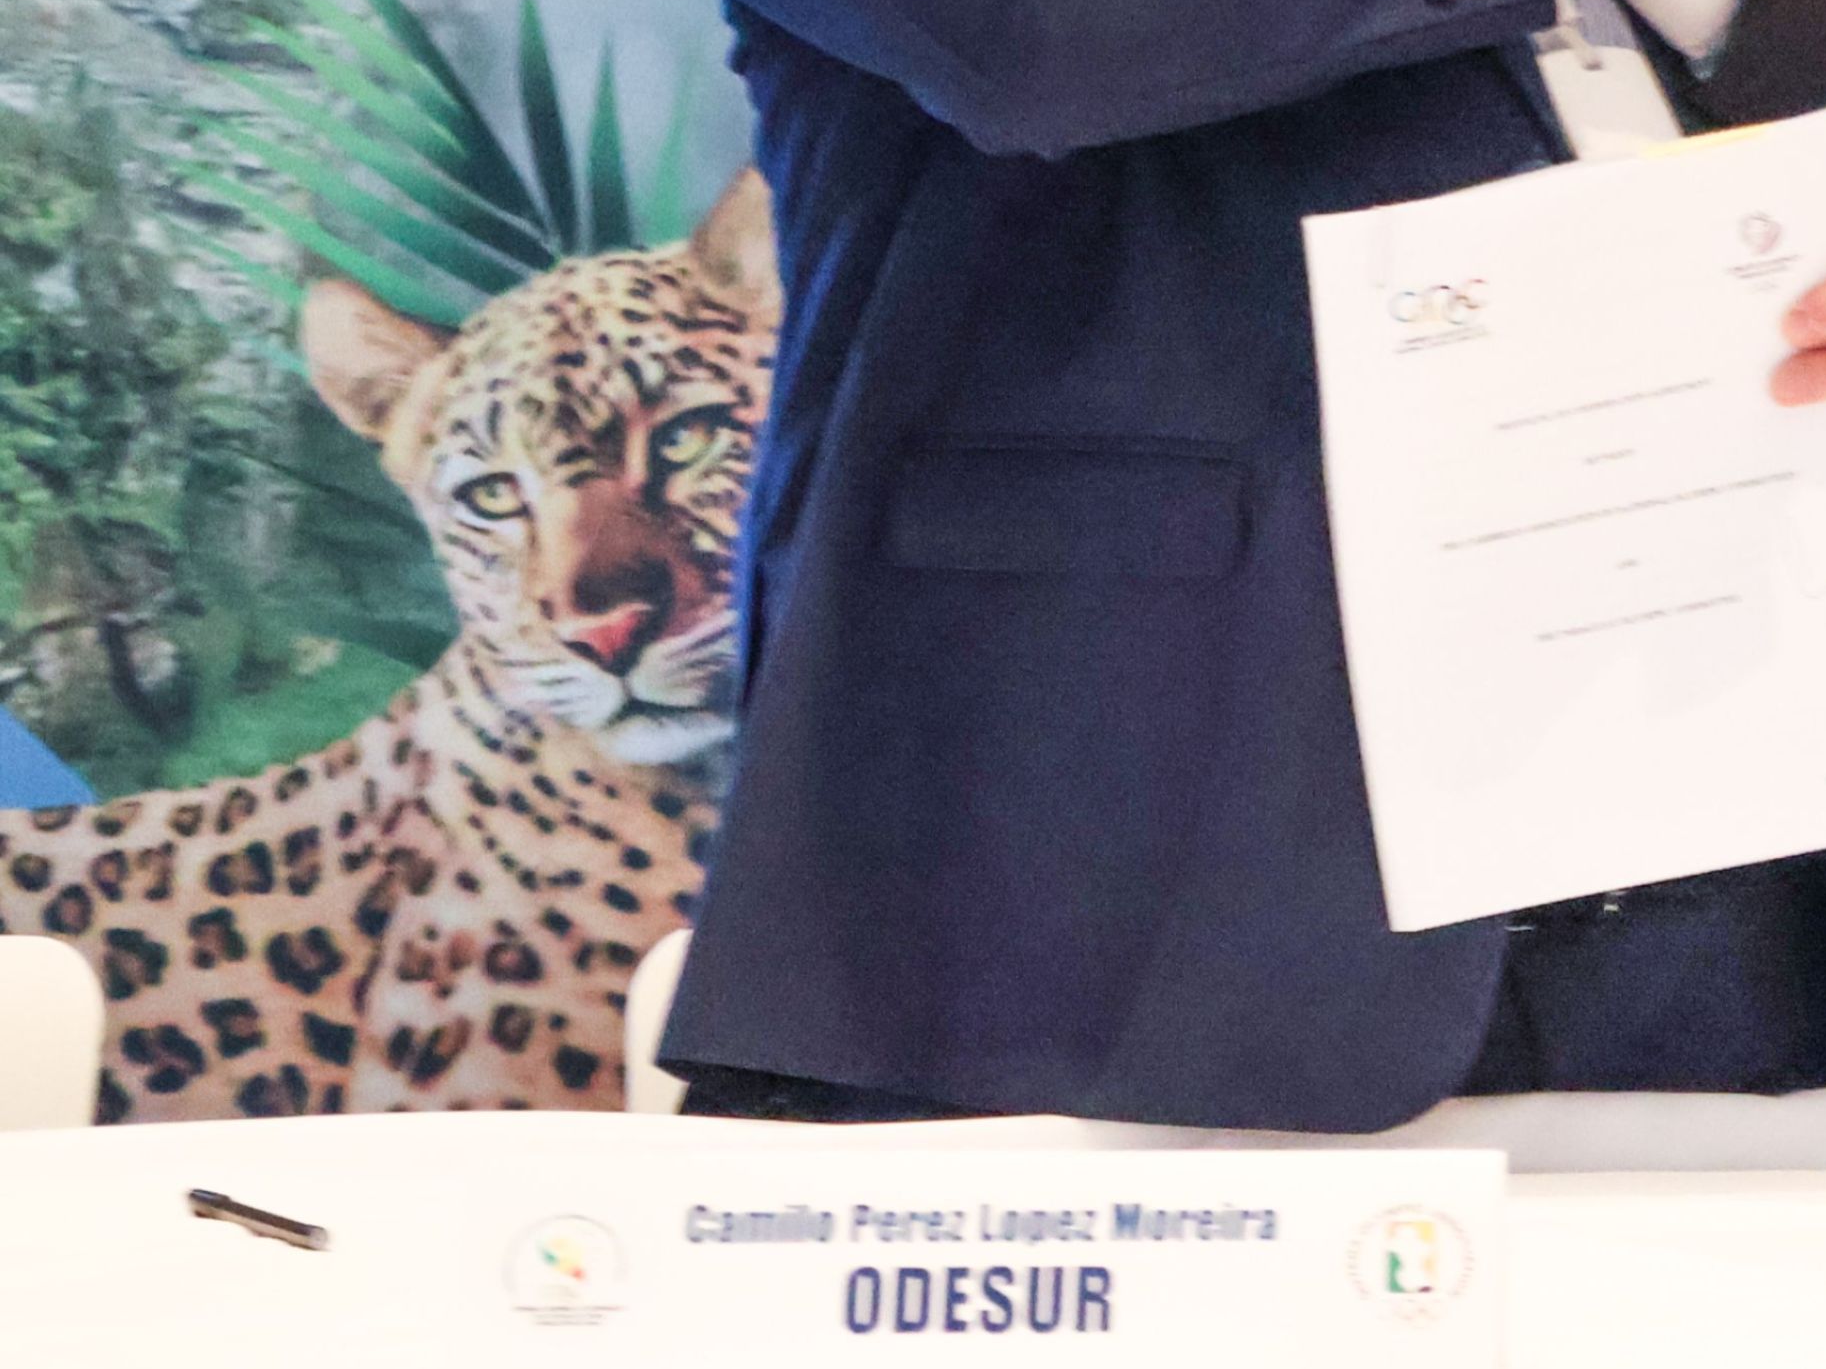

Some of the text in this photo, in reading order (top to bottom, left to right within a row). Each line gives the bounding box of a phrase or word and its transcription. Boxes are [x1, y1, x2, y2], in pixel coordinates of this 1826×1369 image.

[685, 1202, 1276, 1246] Camilo Perez Lopez Moreira
[844, 1265, 1112, 1334] ODESUR
